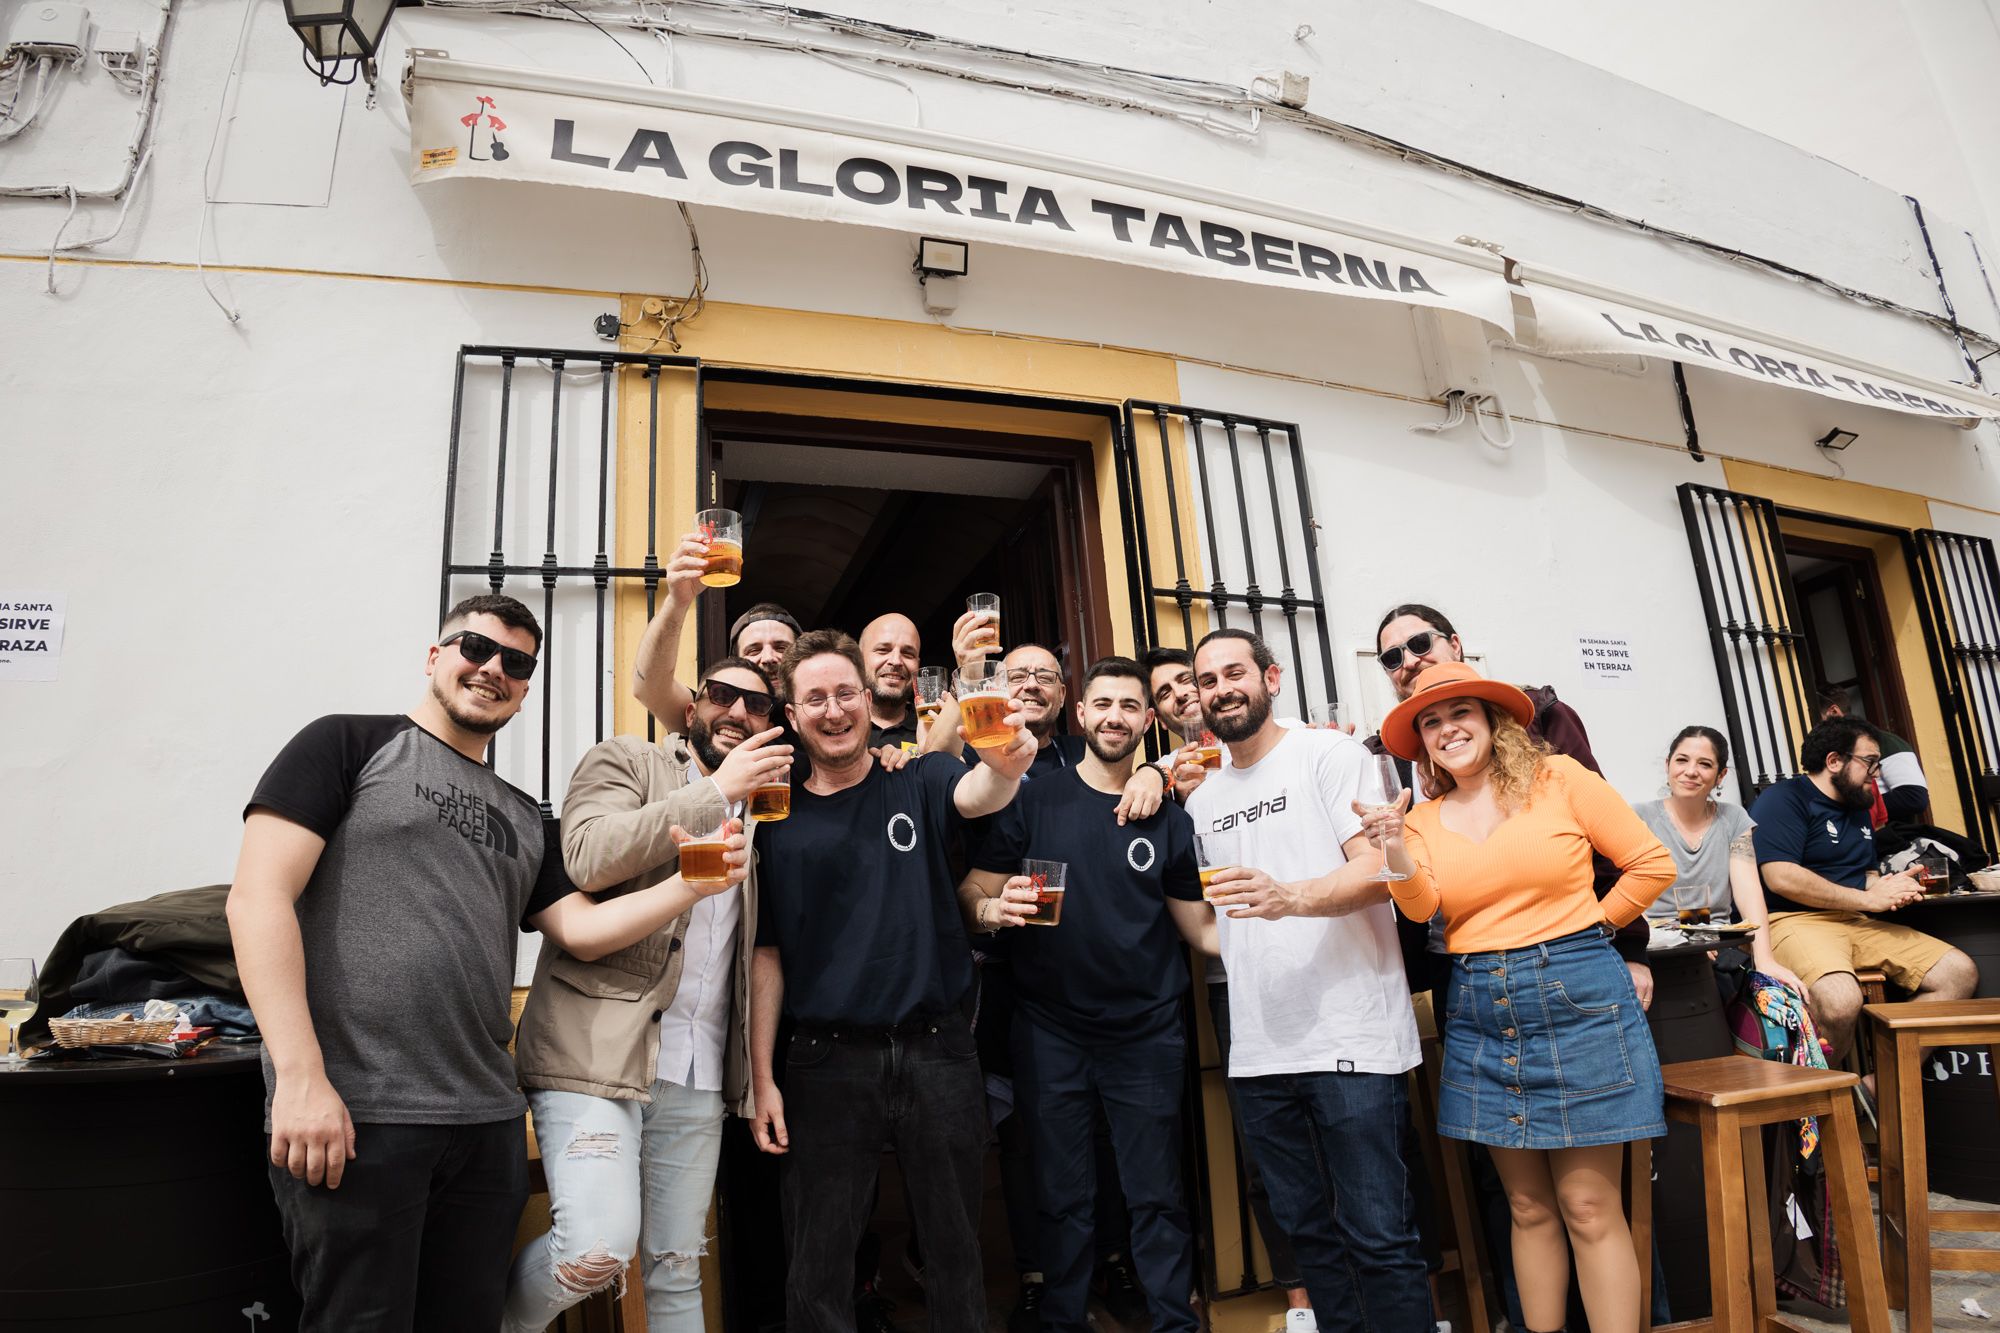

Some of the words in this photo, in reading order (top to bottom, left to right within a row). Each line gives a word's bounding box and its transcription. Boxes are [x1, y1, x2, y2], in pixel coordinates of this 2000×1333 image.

[550, 118, 688, 180] LA
[707, 140, 1076, 232] GLORIA
[1091, 198, 1449, 296] TABERNA
[1600, 312, 1682, 349] LA
[1675, 332, 1844, 392] GLORIA
[14, 603, 53, 612] SANTA
[0, 618, 50, 630] SIRVE
[1582, 648, 1594, 656] NO
[1595, 649, 1606, 657] SE
[1607, 649, 1629, 658] SIRVE
[1584, 662, 1595, 670] EN
[1596, 662, 1632, 672] TERRAZA
[415, 782, 486, 828] NORTH
[446, 782, 484, 812] THE
[438, 807, 486, 845] FACE
